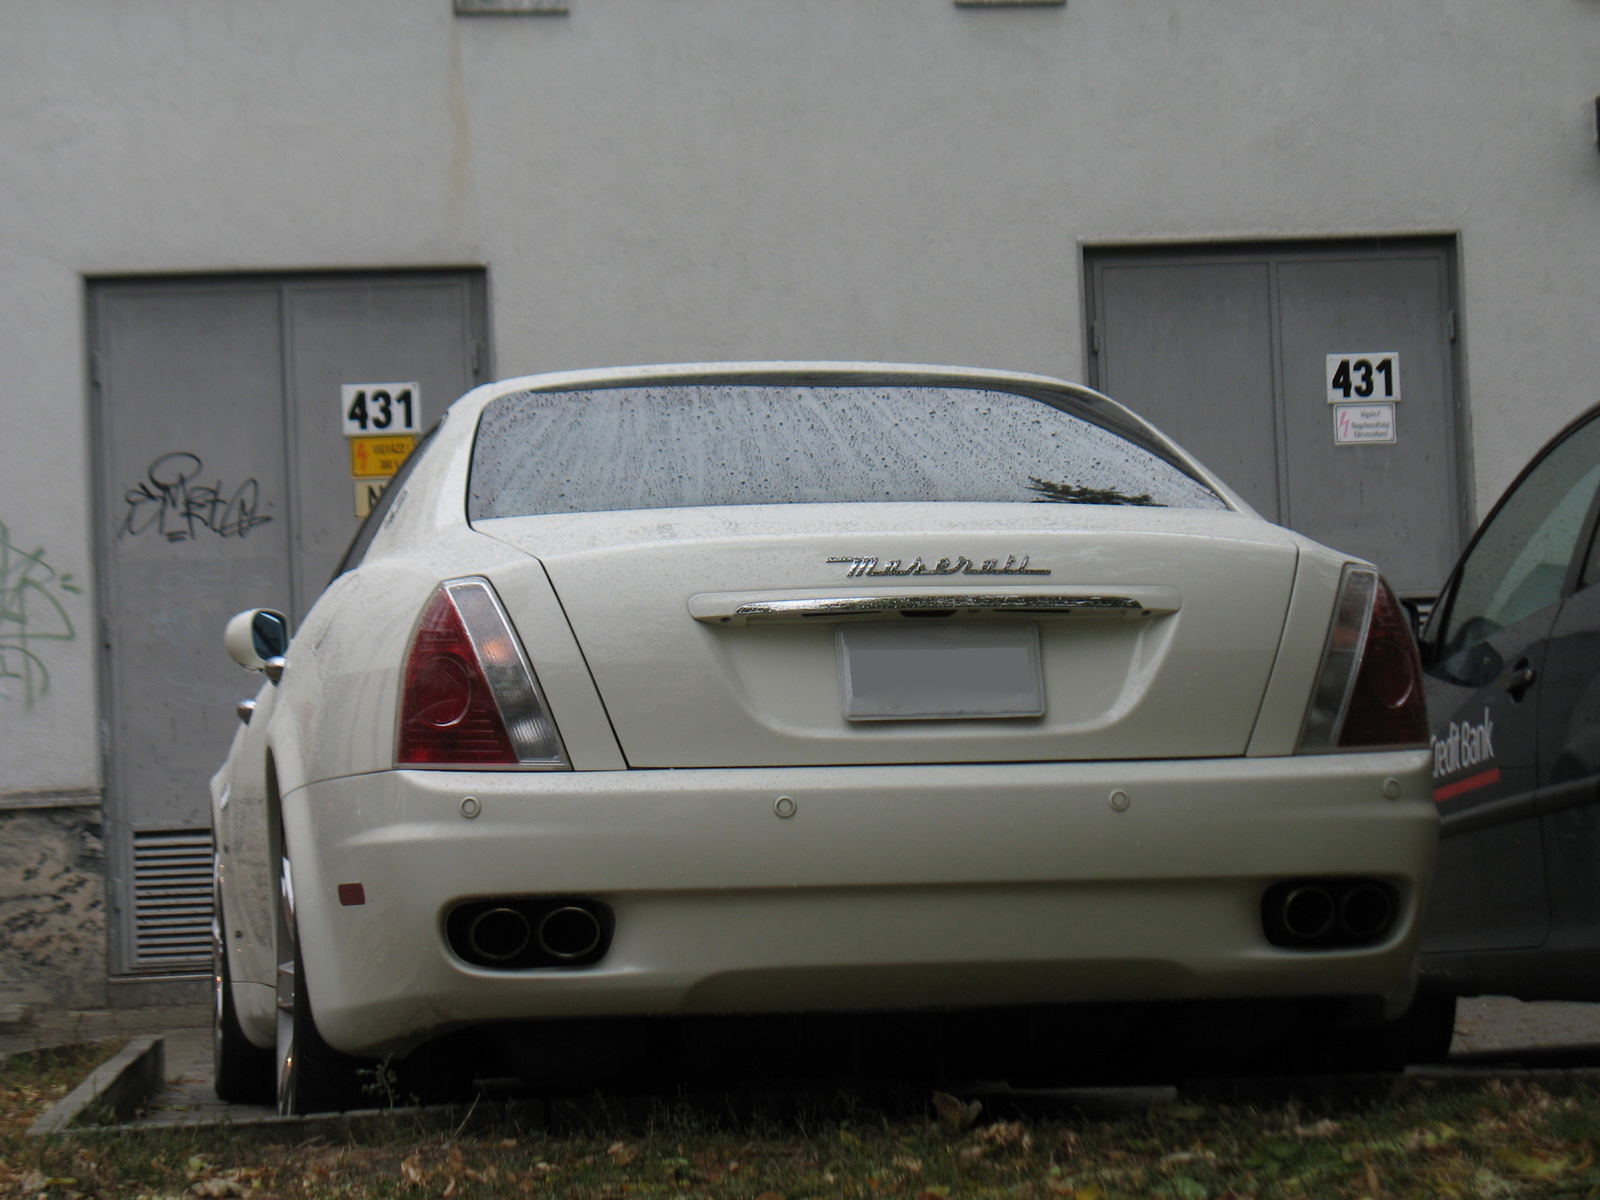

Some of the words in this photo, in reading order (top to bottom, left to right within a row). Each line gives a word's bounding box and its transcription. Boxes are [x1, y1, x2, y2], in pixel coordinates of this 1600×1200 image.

[1332, 358, 1393, 398] 431
[348, 388, 413, 430] 431
[826, 554, 1052, 577] Maserati
[1430, 721, 1461, 778] redit
[1461, 706, 1494, 768] Bank
